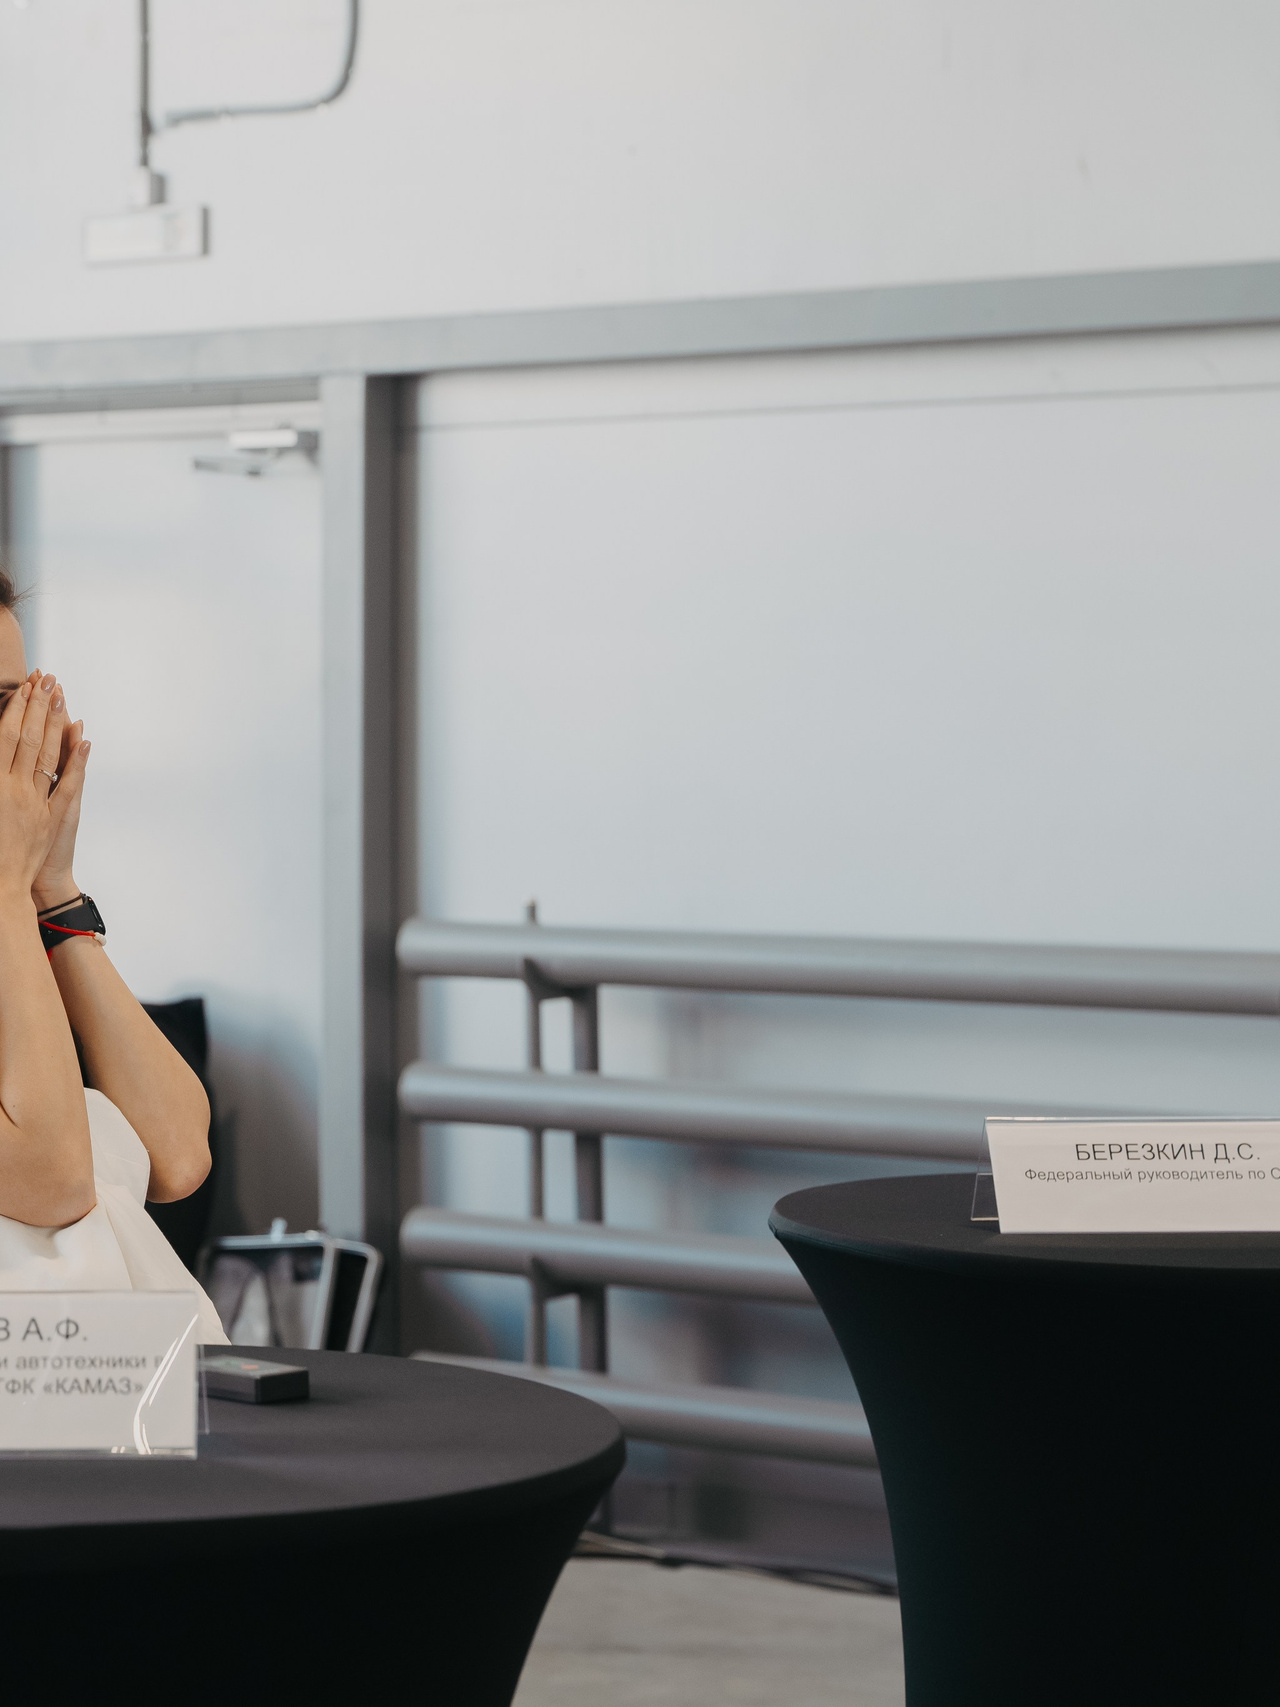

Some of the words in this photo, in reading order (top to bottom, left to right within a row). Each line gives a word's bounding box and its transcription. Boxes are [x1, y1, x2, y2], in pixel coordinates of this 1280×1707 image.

[1075, 1142, 1206, 1161] БЕРЕЗКИН
[1213, 1142, 1261, 1164] Д.С.
[1024, 1168, 1133, 1183] Федеральный
[1137, 1169, 1244, 1183] руководитель
[1248, 1169, 1266, 1180] по
[22, 1317, 88, 1342] А.Ф.
[15, 1354, 147, 1371] автотехники
[42, 1376, 145, 1395] «КАМАЗ»
